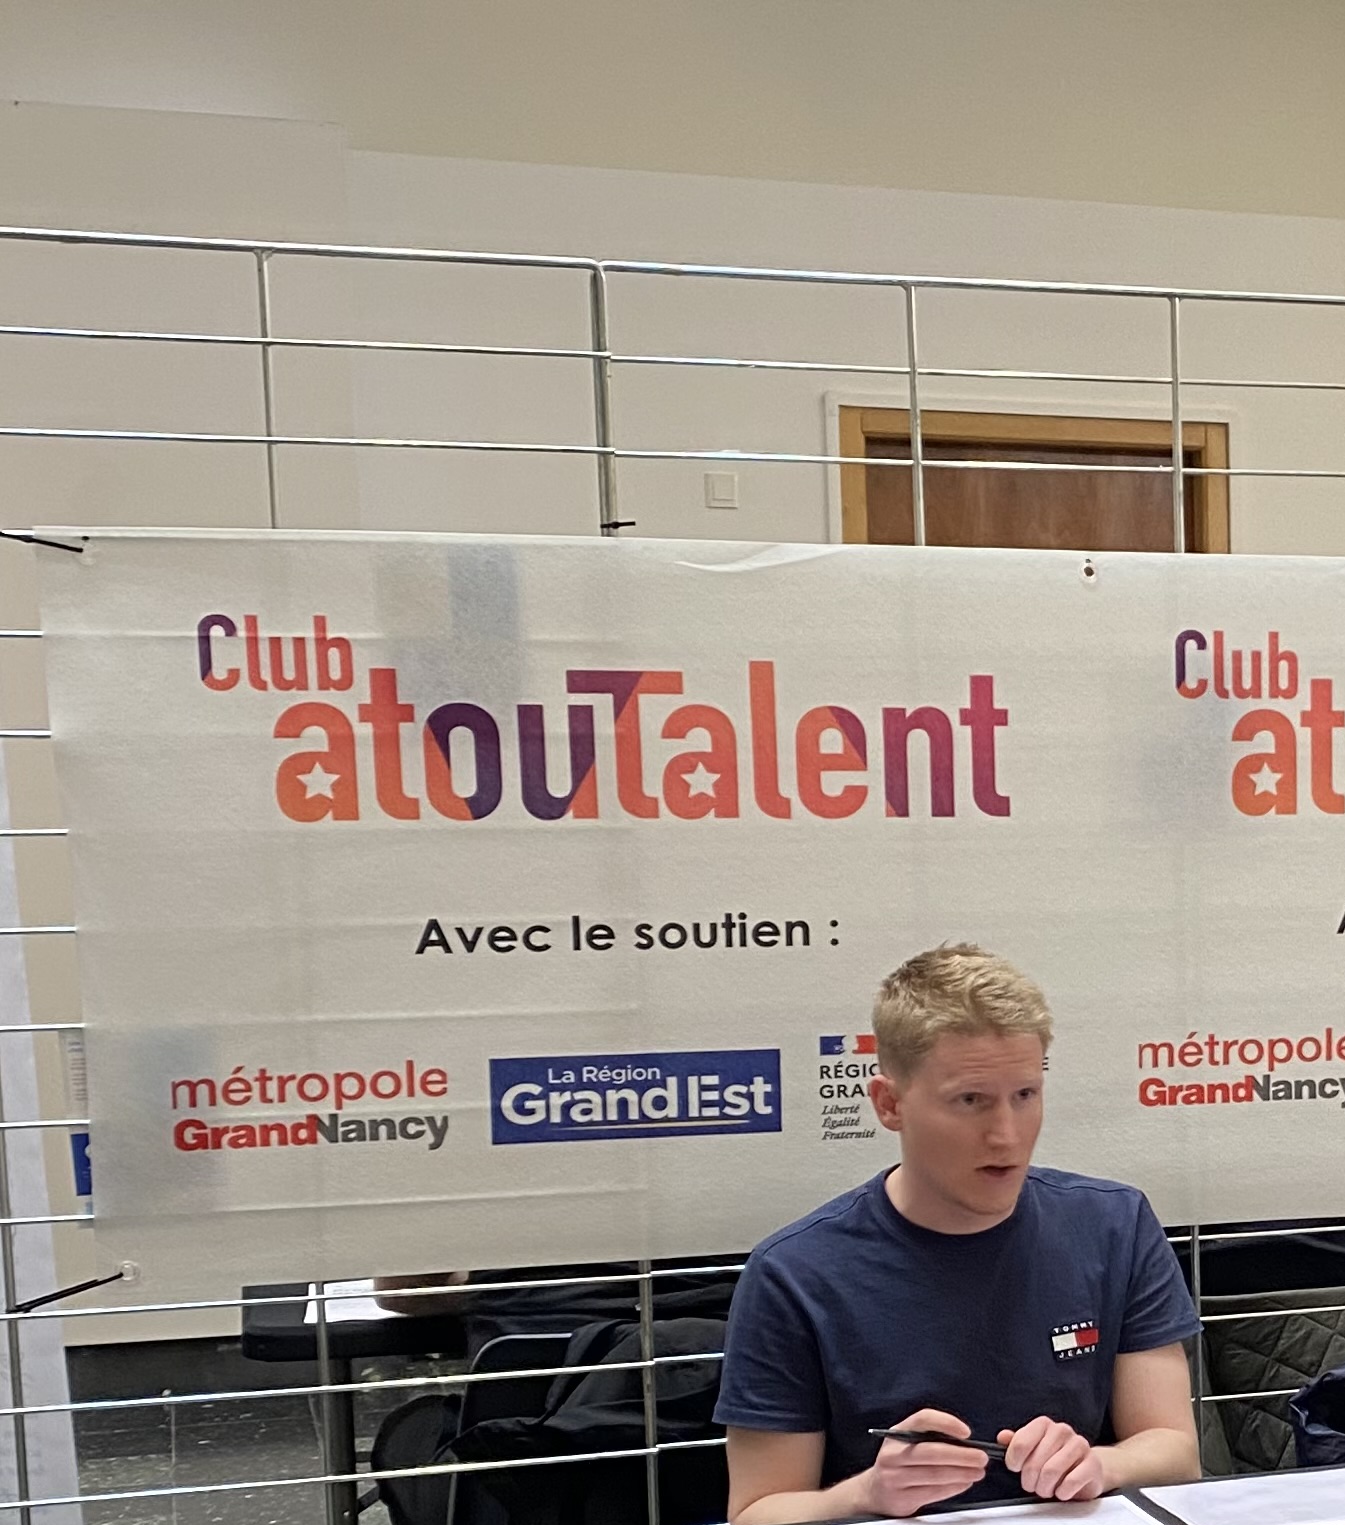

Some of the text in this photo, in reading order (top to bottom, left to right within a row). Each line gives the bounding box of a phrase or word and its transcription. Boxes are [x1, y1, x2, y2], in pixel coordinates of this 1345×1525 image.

[197, 613, 353, 692] Club
[1175, 630, 1298, 699] Club
[273, 660, 1010, 823] atouTalent
[415, 917, 551, 957] Avec
[570, 914, 615, 952] le
[633, 912, 811, 952] soutien
[172, 1059, 448, 1110] métropole
[548, 1064, 661, 1084] La Région
[821, 1104, 860, 1115] Liberté
[821, 1128, 876, 1140] Fraternité
[1053, 1321, 1093, 1334] TOMMY
